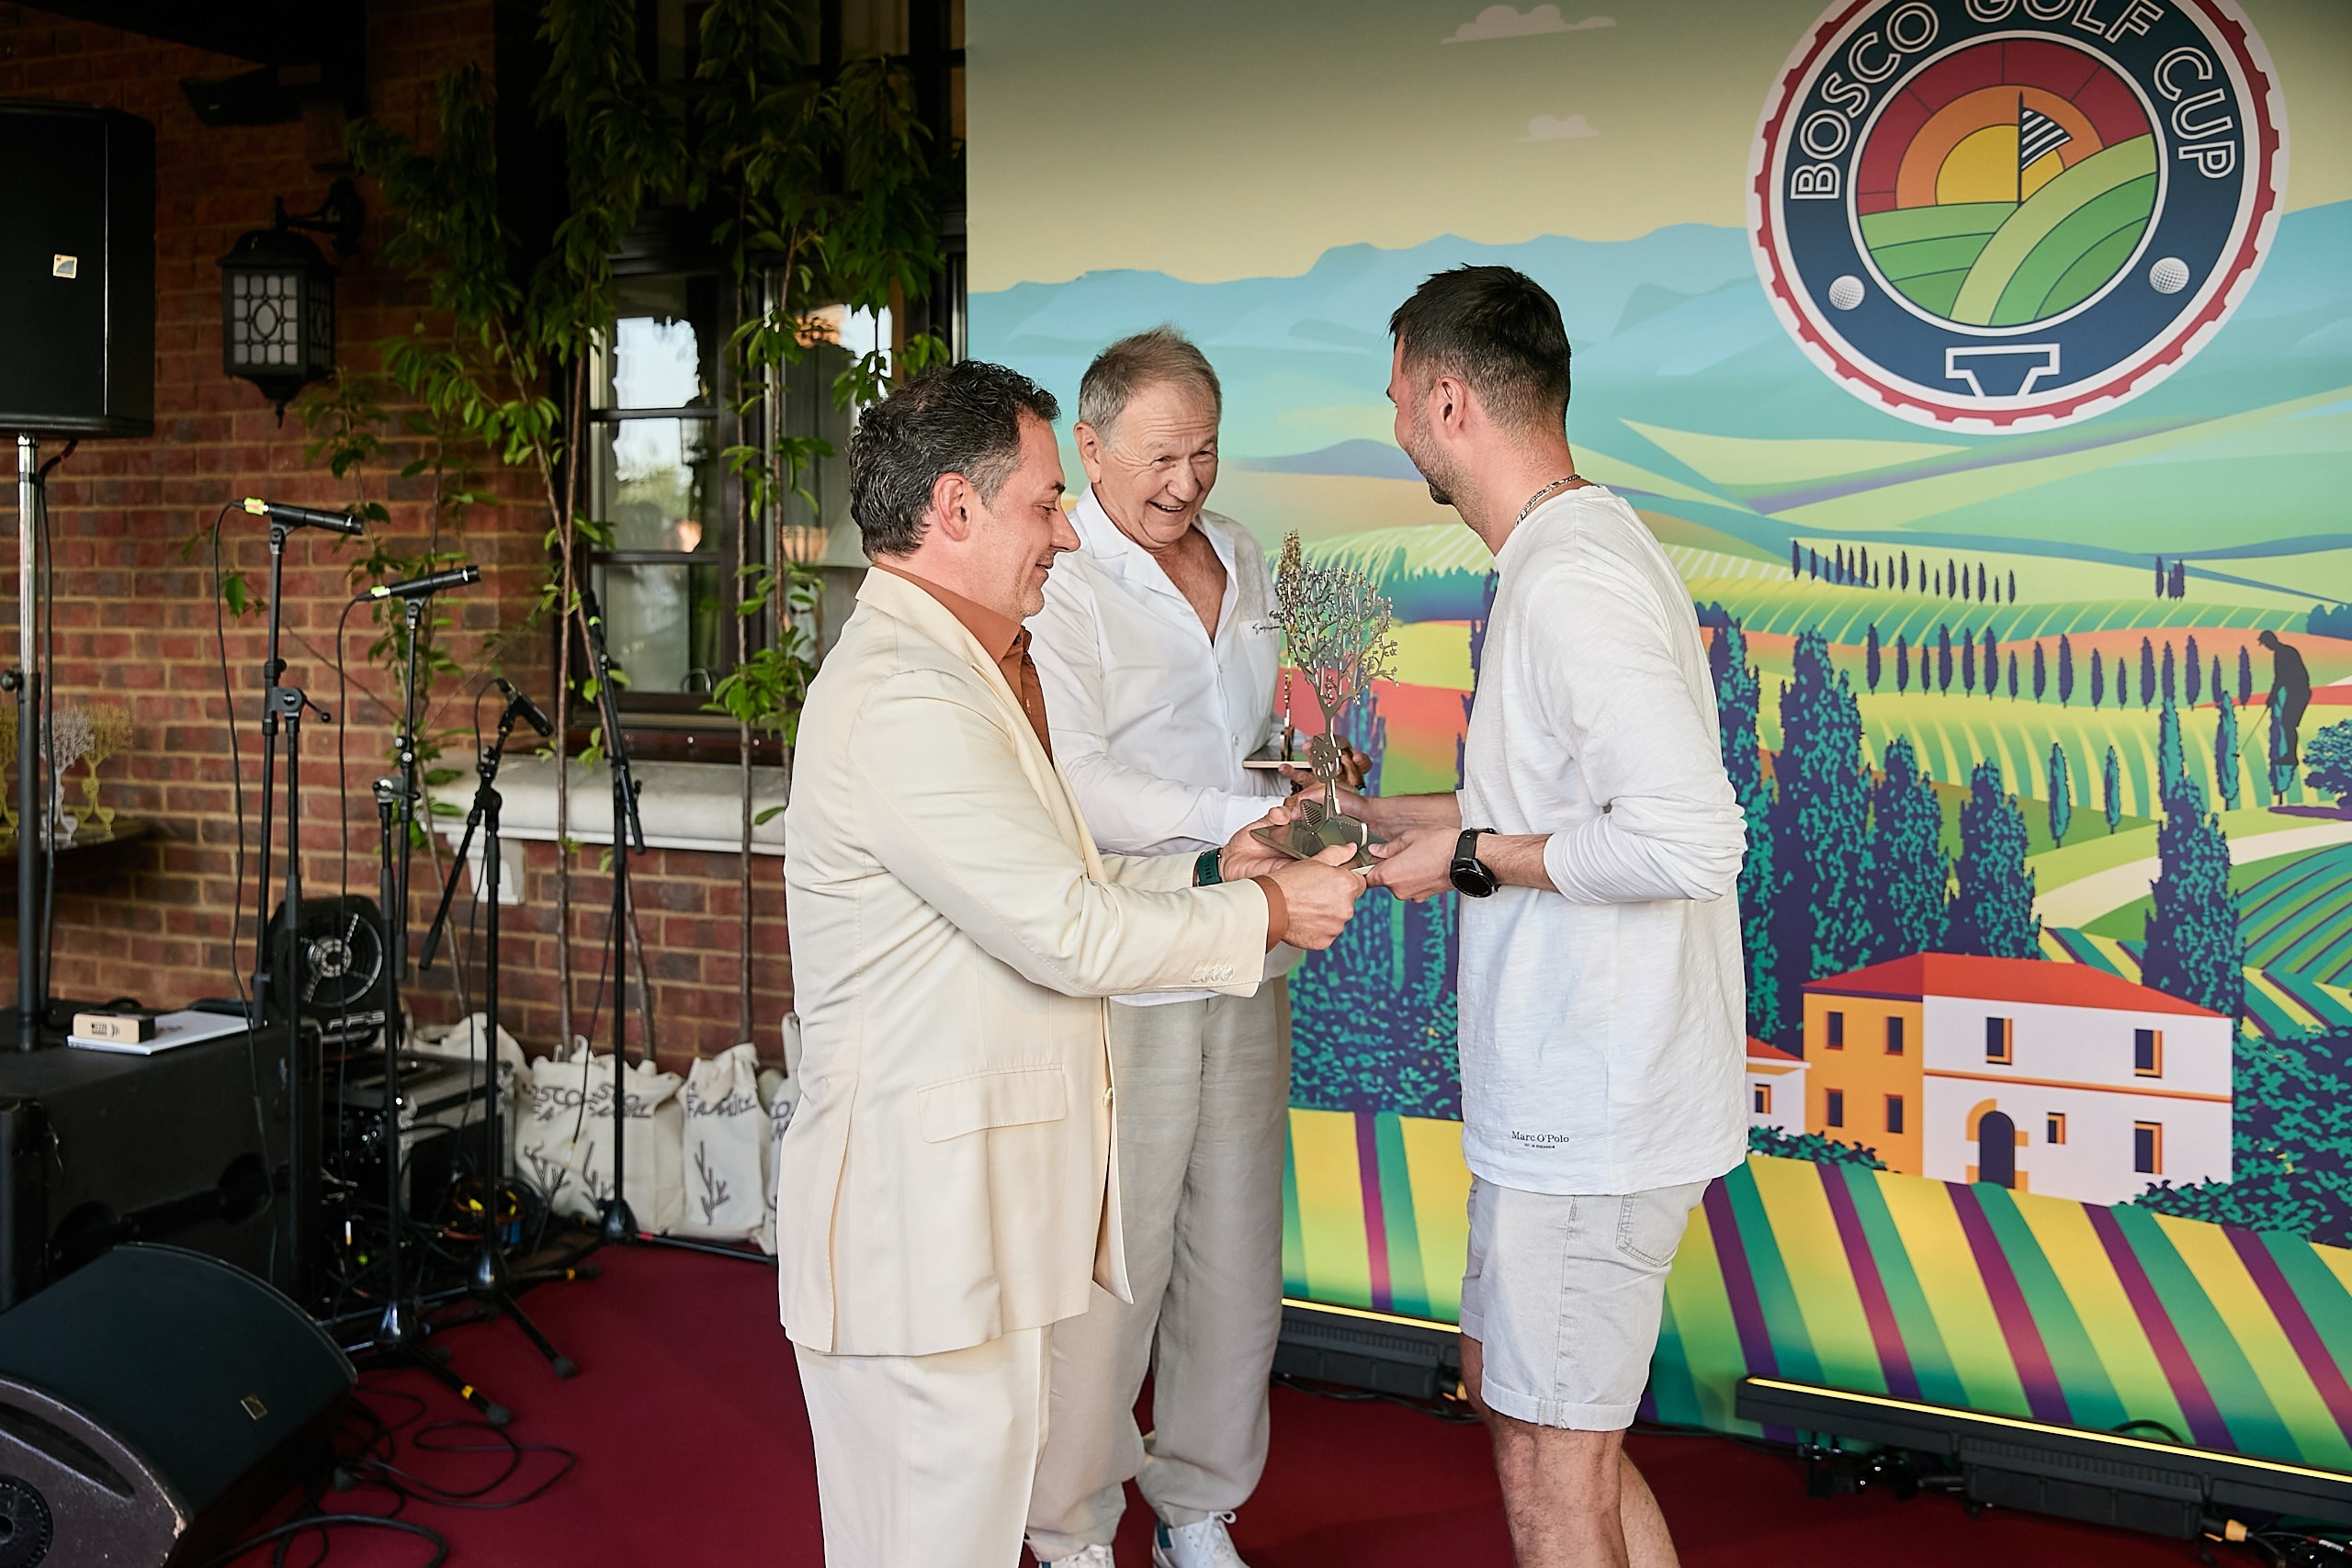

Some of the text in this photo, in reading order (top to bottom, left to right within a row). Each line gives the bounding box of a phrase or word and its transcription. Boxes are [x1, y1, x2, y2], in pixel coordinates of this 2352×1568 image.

[1791, 1, 1939, 199] BOSCO
[2154, 47, 2236, 179] CUP
[1511, 1130, 1569, 1143] Marc O'Polo
